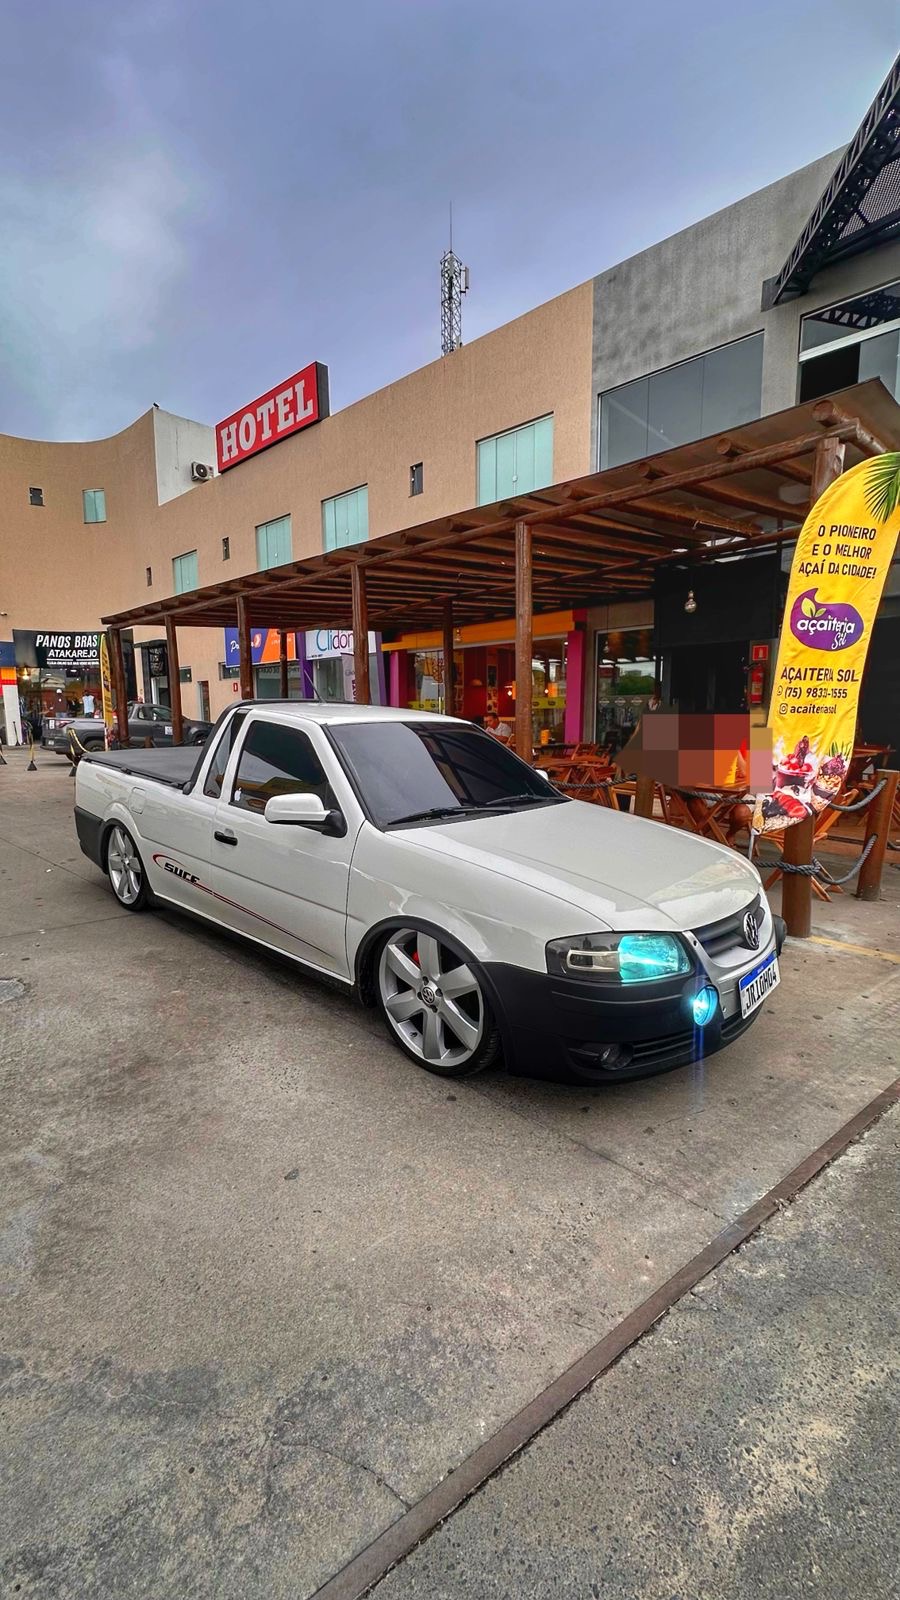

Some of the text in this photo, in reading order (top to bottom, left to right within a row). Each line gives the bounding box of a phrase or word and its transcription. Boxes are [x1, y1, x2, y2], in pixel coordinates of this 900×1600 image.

[220, 379, 314, 463] HOTEL
[818, 525, 877, 540] O PIONEIRO
[812, 543, 872, 560] E O MELHOR
[798, 559, 877, 579] AÇAÍ DA CIDADE!
[796, 615, 856, 636] açaiteria
[35, 634, 98, 649] PANOS BRAS
[48, 648, 98, 658] ATAKAREJO
[836, 668, 860, 682] SOL
[784, 686, 802, 699] (75)
